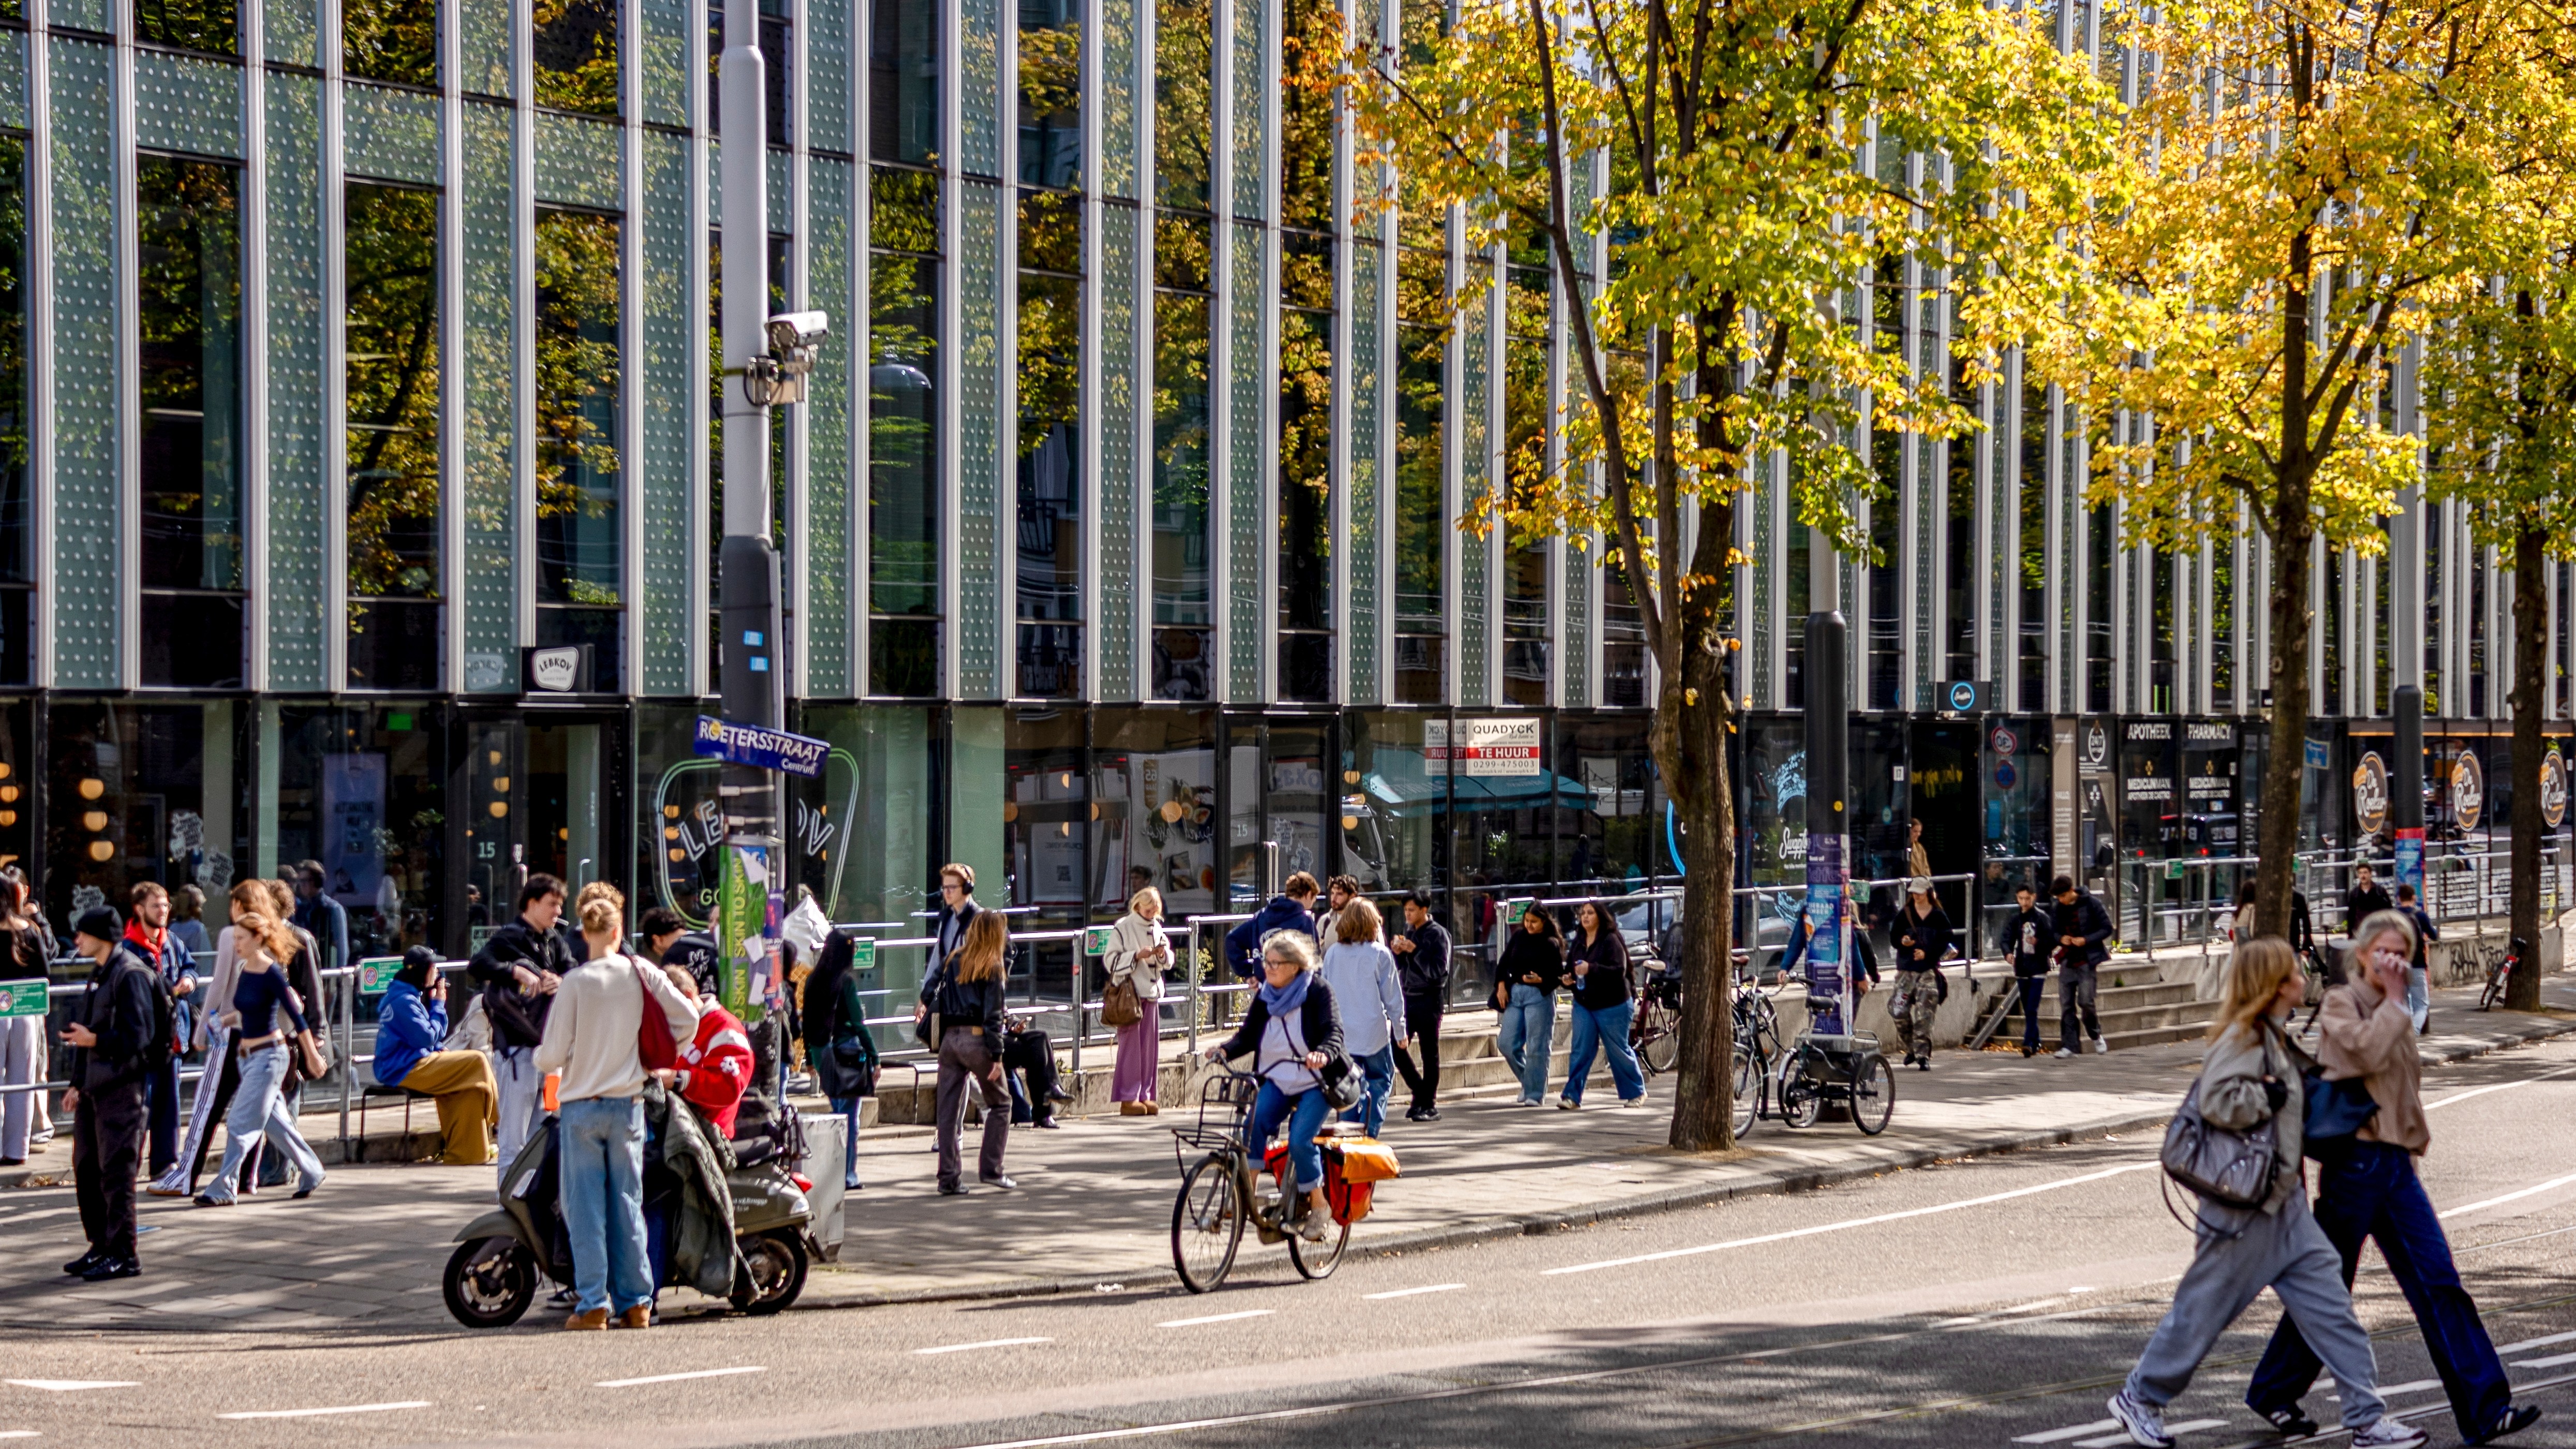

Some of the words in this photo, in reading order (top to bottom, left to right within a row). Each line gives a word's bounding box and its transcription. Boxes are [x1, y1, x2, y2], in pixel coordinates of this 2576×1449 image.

[539, 657, 572, 673] LEBKOV
[1473, 725, 1534, 734] QUADYCK
[2127, 724, 2171, 740] APOTHEEK
[2188, 724, 2231, 740] PHARMACY
[699, 720, 825, 761] ROETERSSTRAAT
[1478, 748, 1492, 758] TE
[1496, 748, 1530, 758] HUUR
[781, 758, 816, 775] Centrum
[1473, 760, 1535, 768] 0299-475003
[1237, 824, 1248, 836] 15
[478, 842, 495, 858] 15
[733, 857, 745, 894] SKIN
[733, 898, 745, 921] TO
[733, 925, 745, 957] SKIN
[733, 969, 745, 1006] SKIN
